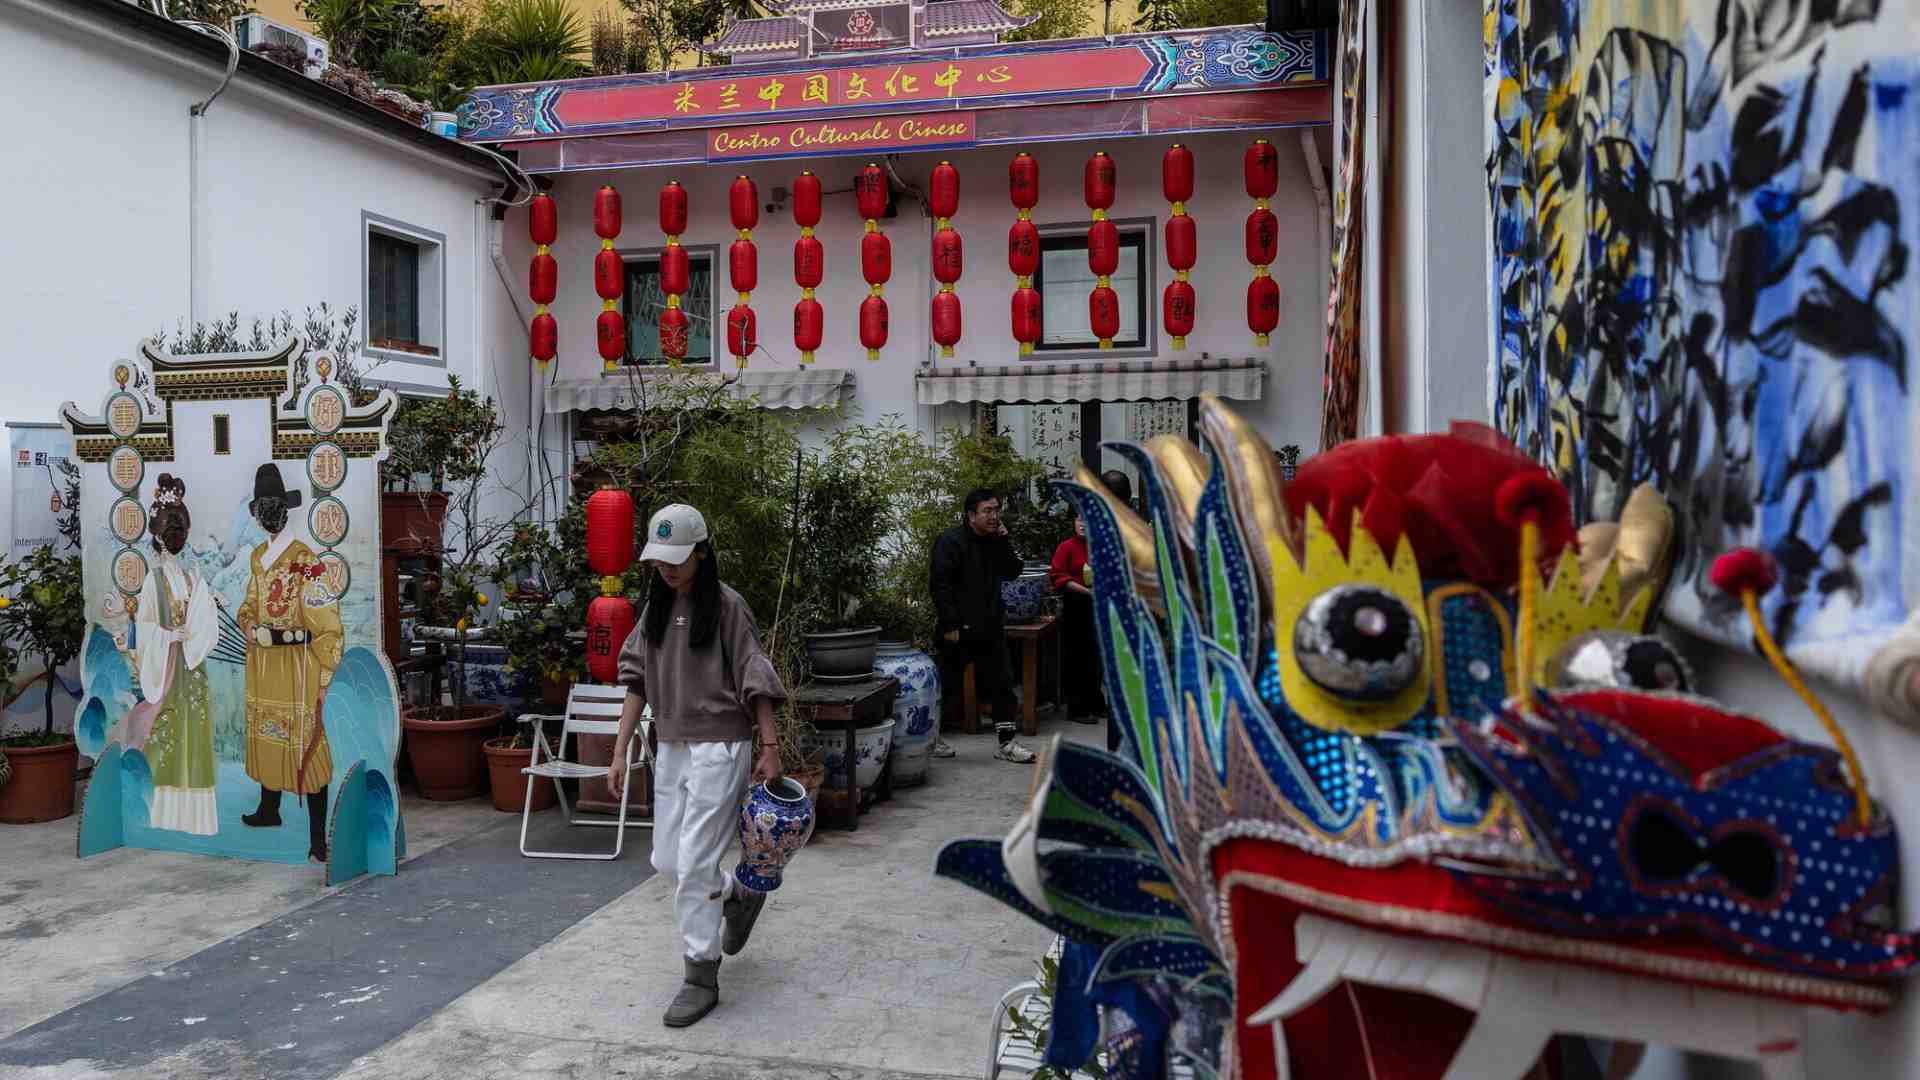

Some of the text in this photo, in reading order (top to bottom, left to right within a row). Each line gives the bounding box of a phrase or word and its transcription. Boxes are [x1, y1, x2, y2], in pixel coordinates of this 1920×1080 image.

[673, 64, 1013, 113] 米兰中国文化中心
[714, 119, 968, 153] Centro Culturale Cinese
